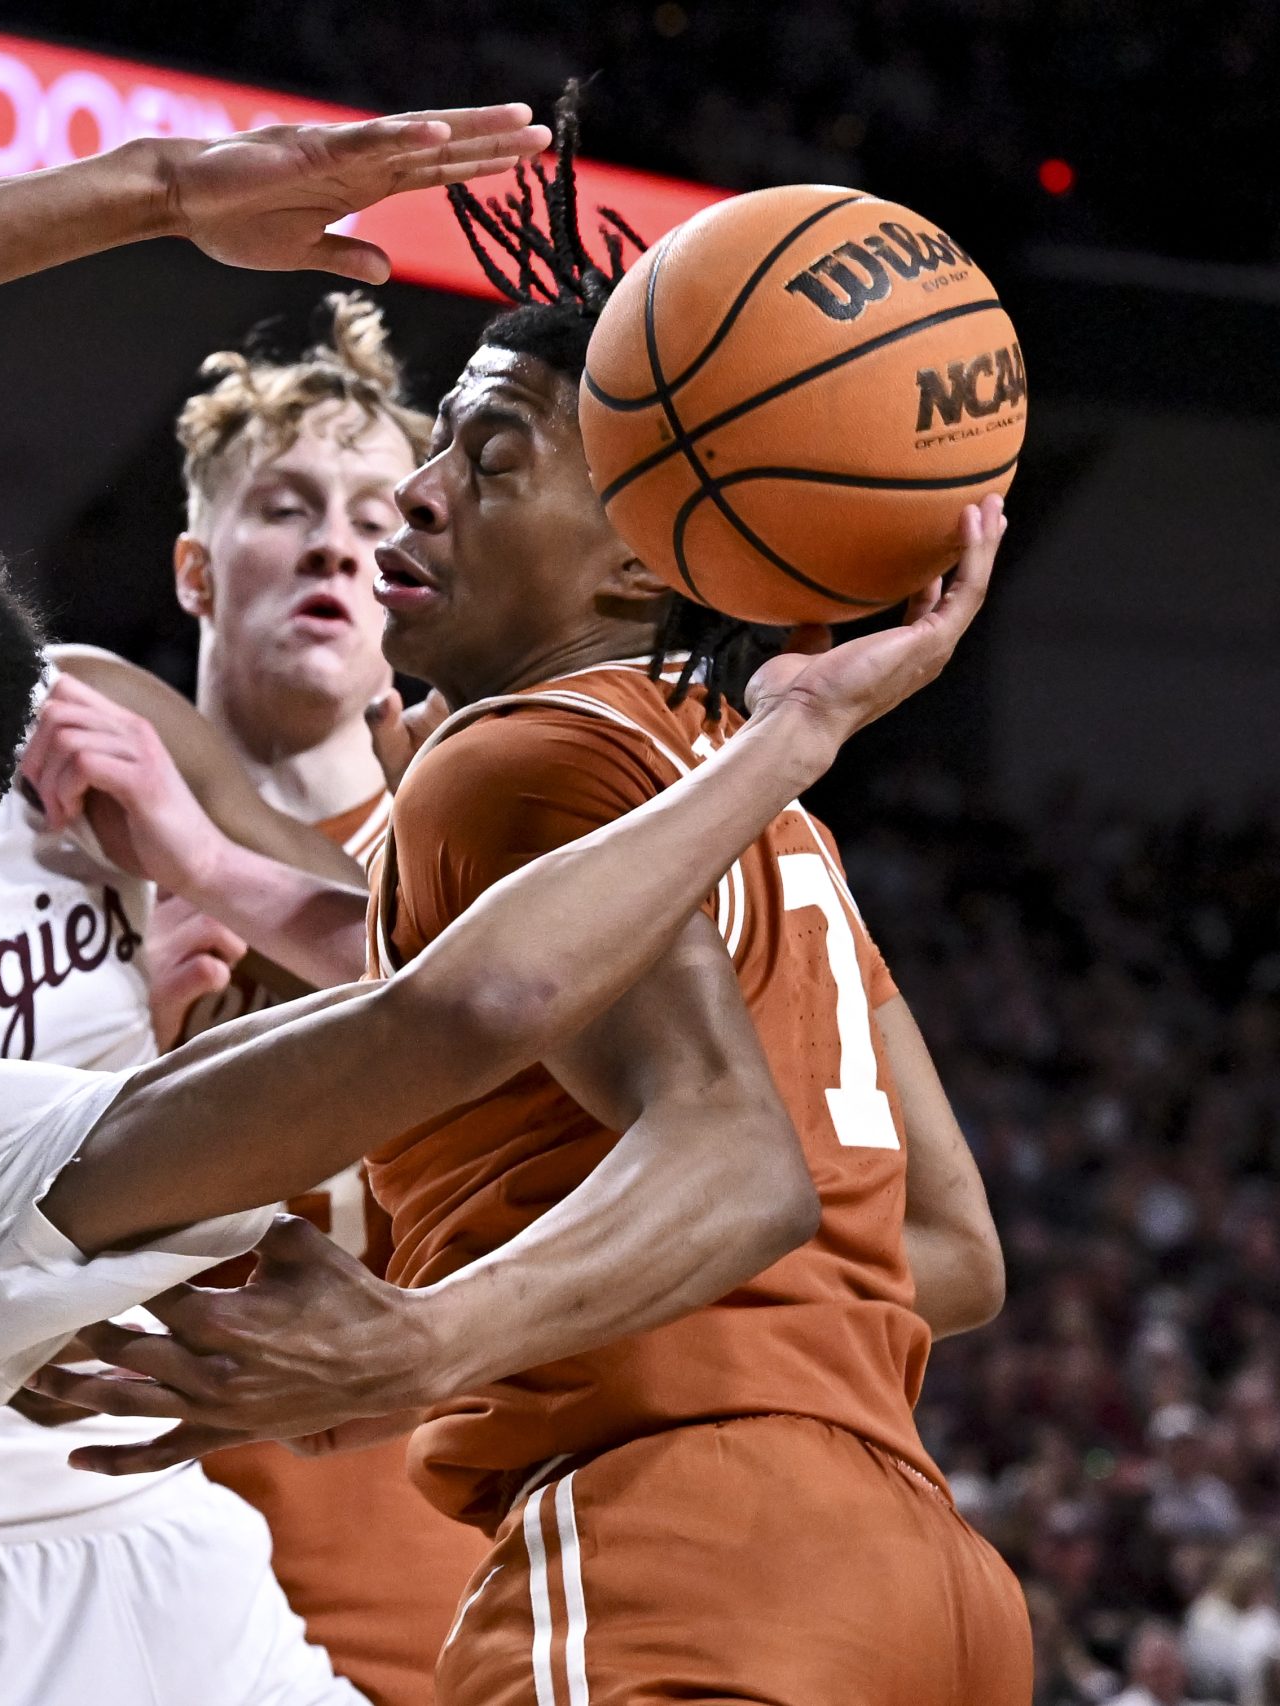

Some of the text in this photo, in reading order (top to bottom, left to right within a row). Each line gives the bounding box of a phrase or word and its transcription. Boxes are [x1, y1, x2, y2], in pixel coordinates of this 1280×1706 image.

[785, 222, 974, 323] Wilso
[915, 427, 982, 450] OFFICIAL
[777, 853, 901, 1150] 1
